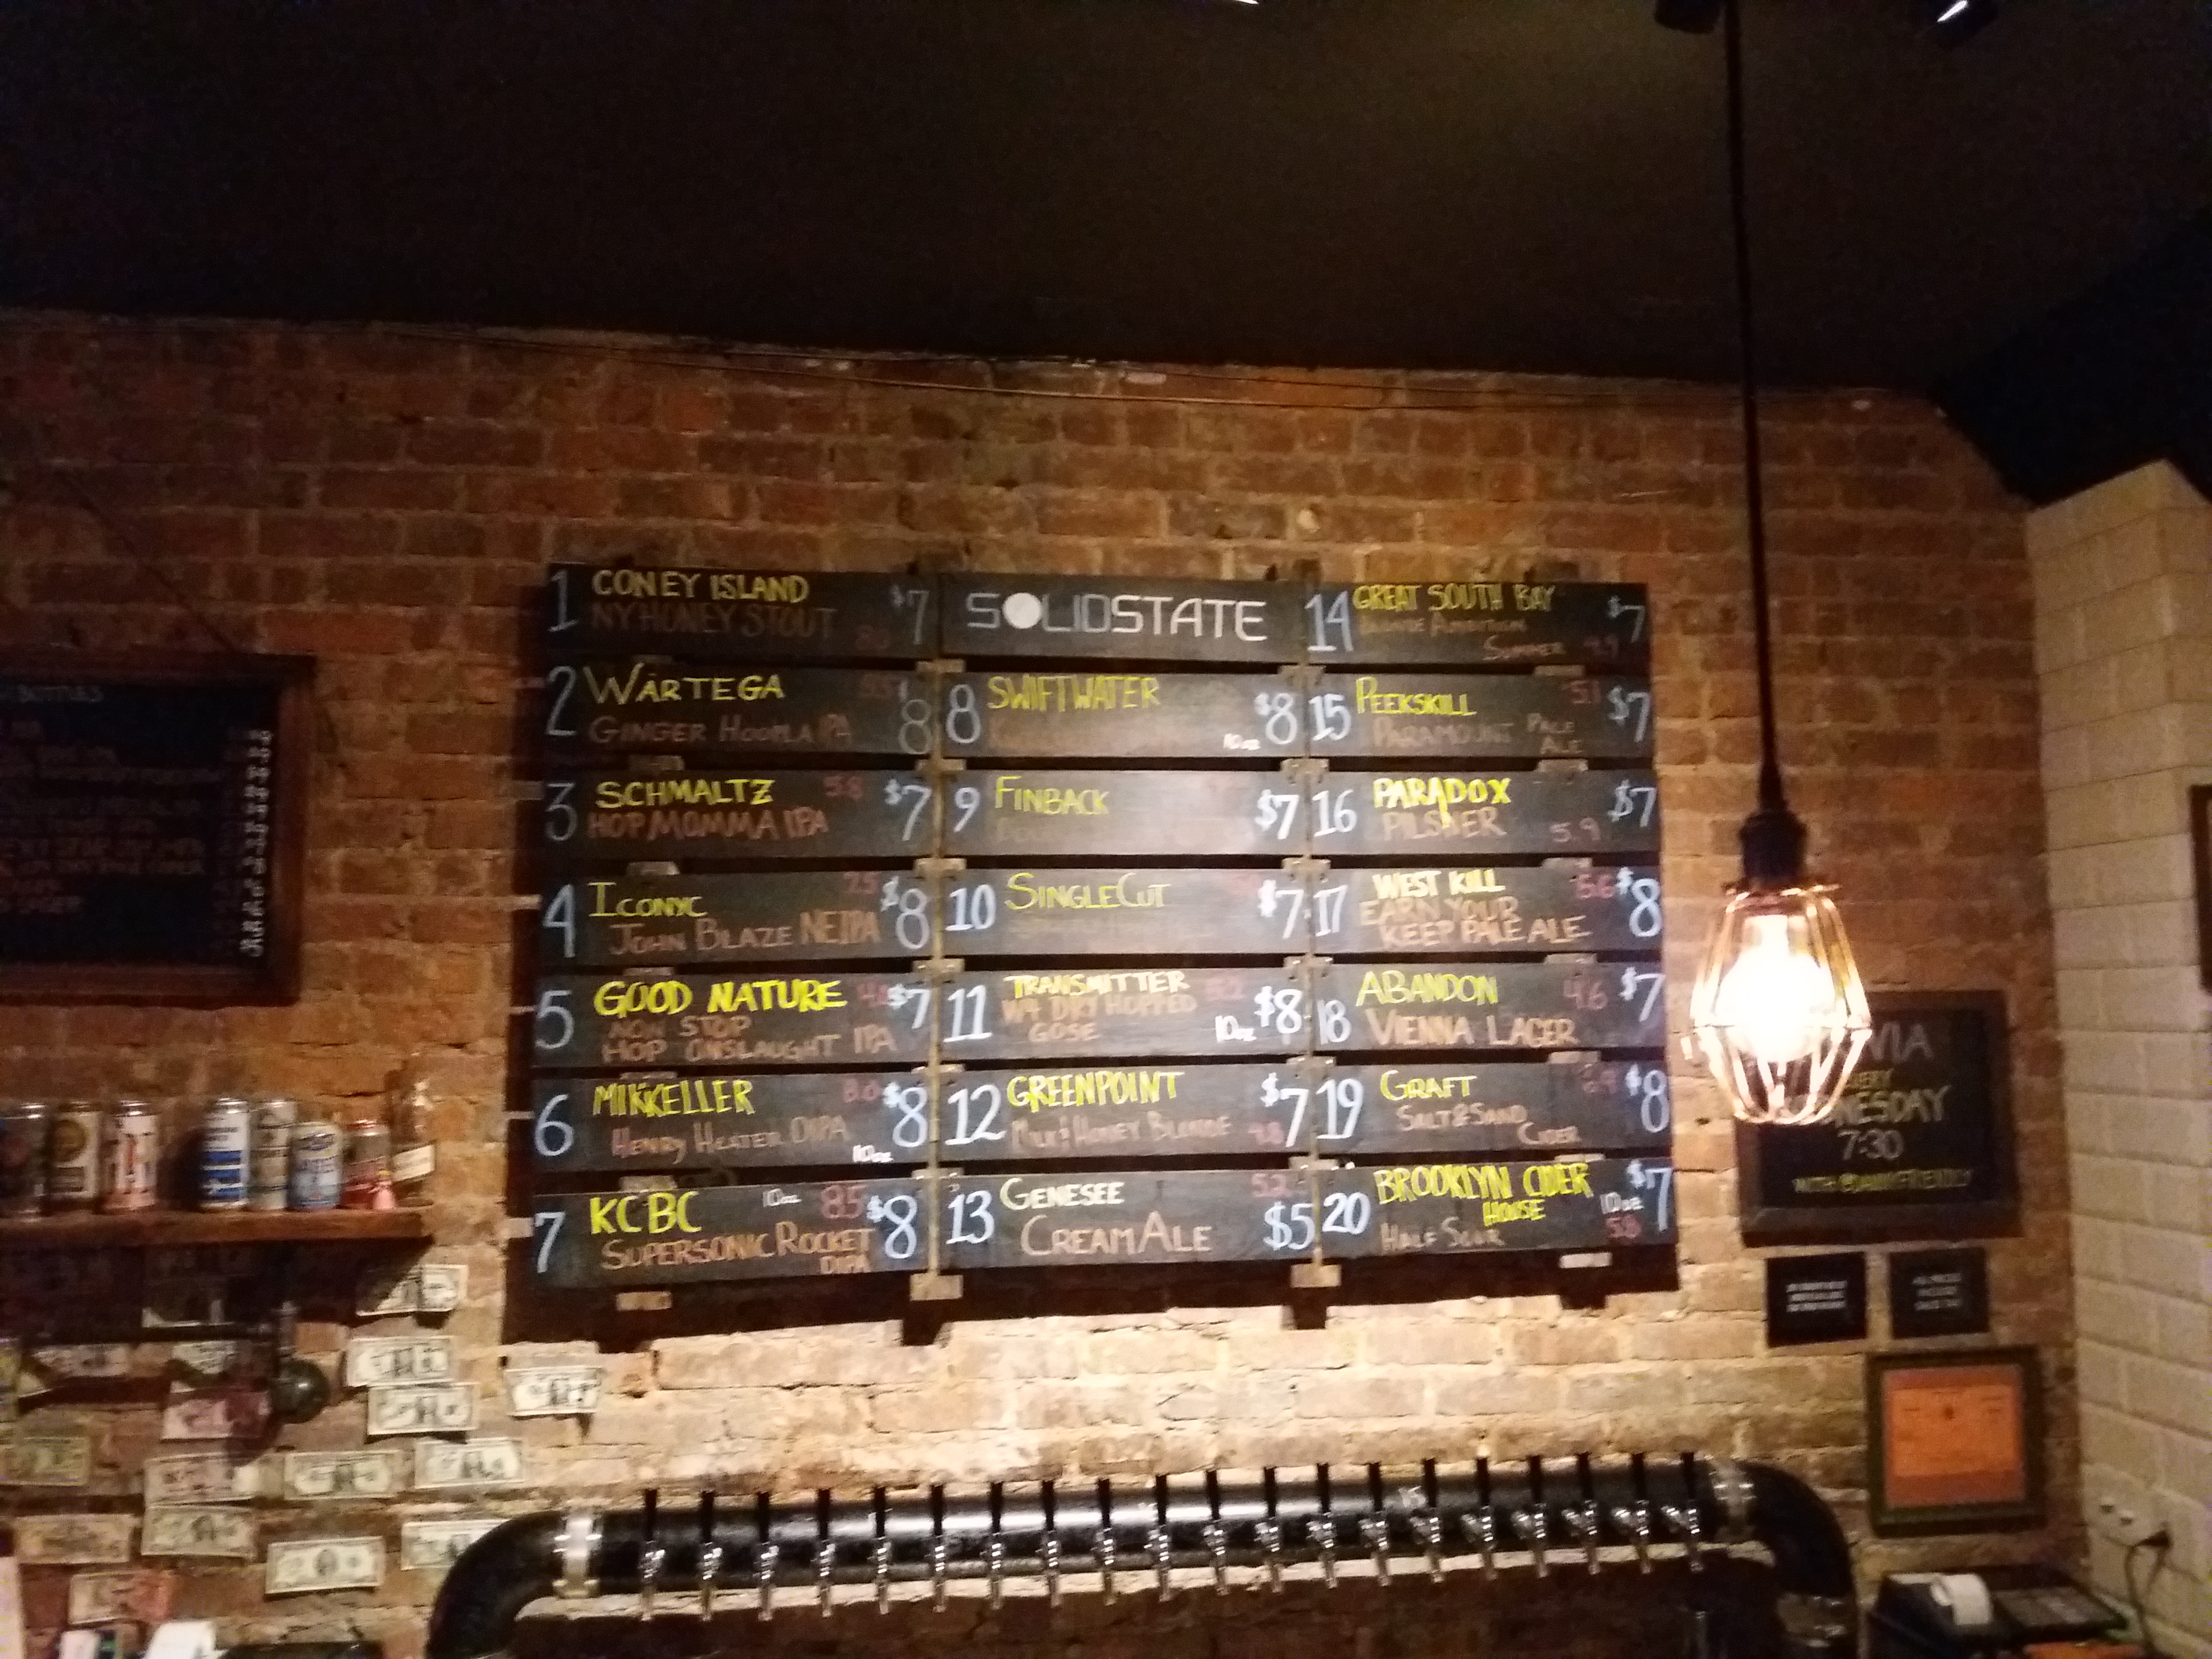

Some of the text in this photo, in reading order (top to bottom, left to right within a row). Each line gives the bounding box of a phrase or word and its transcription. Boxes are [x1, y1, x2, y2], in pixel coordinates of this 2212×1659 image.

[549, 569, 579, 632] 1
[592, 569, 810, 603] CONEY ISLAND
[1353, 583, 1556, 612] GREAT SOUTH BAY
[591, 601, 837, 638] NY HONEY STOUT
[1304, 590, 1355, 653] 14
[1608, 594, 1645, 642] $7
[545, 665, 577, 737] 2
[946, 683, 982, 744] 8
[1254, 691, 1298, 745] $8
[1307, 694, 1351, 742] 15
[1356, 676, 1477, 716] PEEKSKILL
[1608, 685, 1651, 742] $7
[589, 715, 707, 745] GINGER
[545, 781, 579, 841] 3
[595, 778, 776, 808] SCHMALTZ
[884, 778, 932, 842] $7
[953, 787, 981, 833] 9
[995, 775, 1109, 816] FINBACK
[1256, 789, 1299, 841] $7
[1312, 789, 1358, 838] 16
[1373, 777, 1511, 810] PARADOX
[1608, 779, 1656, 827] $7
[588, 806, 829, 842] HOP MOMMA IPA
[1383, 807, 1507, 841] PILSNER
[945, 883, 996, 931] 10
[1372, 869, 1506, 899] WEST KILL
[1616, 866, 1661, 938] $8
[542, 884, 576, 958] 4
[696, 917, 794, 951] BLAZE
[799, 910, 881, 945] NEIPA
[880, 876, 931, 950] $8
[1257, 879, 1304, 939] $7
[1313, 884, 1349, 937] 17
[1359, 896, 1520, 926] EARN YOUR
[1379, 915, 1593, 950] KEEP PALE ALE
[594, 979, 848, 1018] GOOD NATURE
[887, 984, 931, 1029] $7
[1254, 985, 1303, 1037] $8
[1356, 970, 1499, 1007] ABANDON
[1620, 967, 1665, 1022] $7
[536, 990, 574, 1050] 5
[679, 1015, 751, 1038] STOP
[943, 984, 993, 1044] 11
[1028, 1022, 1098, 1043] GOSE
[1316, 999, 1351, 1045] 18
[1364, 1009, 1475, 1045] VIENNA
[601, 1038, 667, 1063] HOP
[853, 1024, 898, 1054] IPA
[593, 1079, 756, 1117] MIKKELLER
[1007, 1070, 1185, 1113] GREENPOINT
[1316, 1078, 1364, 1139] 19
[1380, 1069, 1478, 1101] GRAFT
[1625, 1064, 1669, 1133] $8
[534, 1094, 574, 1156] 6
[883, 1081, 928, 1149] $8
[945, 1084, 1006, 1146] 12
[1260, 1072, 1309, 1148] $7
[1837, 1128, 1903, 1161] 7:30
[1000, 1178, 1125, 1210] GENESEE
[1373, 1162, 1594, 1205] BROOKLYN CIDER
[1626, 1159, 1673, 1231] $7
[590, 1191, 701, 1235] KCBC
[866, 1194, 918, 1260] $8
[946, 1190, 995, 1245] 13
[1022, 1211, 1213, 1255] CREAM ALE
[1264, 1201, 1314, 1250] $5
[1322, 1191, 1371, 1234] 20
[1483, 1198, 1546, 1227] HOUSE
[535, 1212, 566, 1274] 7
[600, 1221, 875, 1271] SUPERSONIC ROCKET
